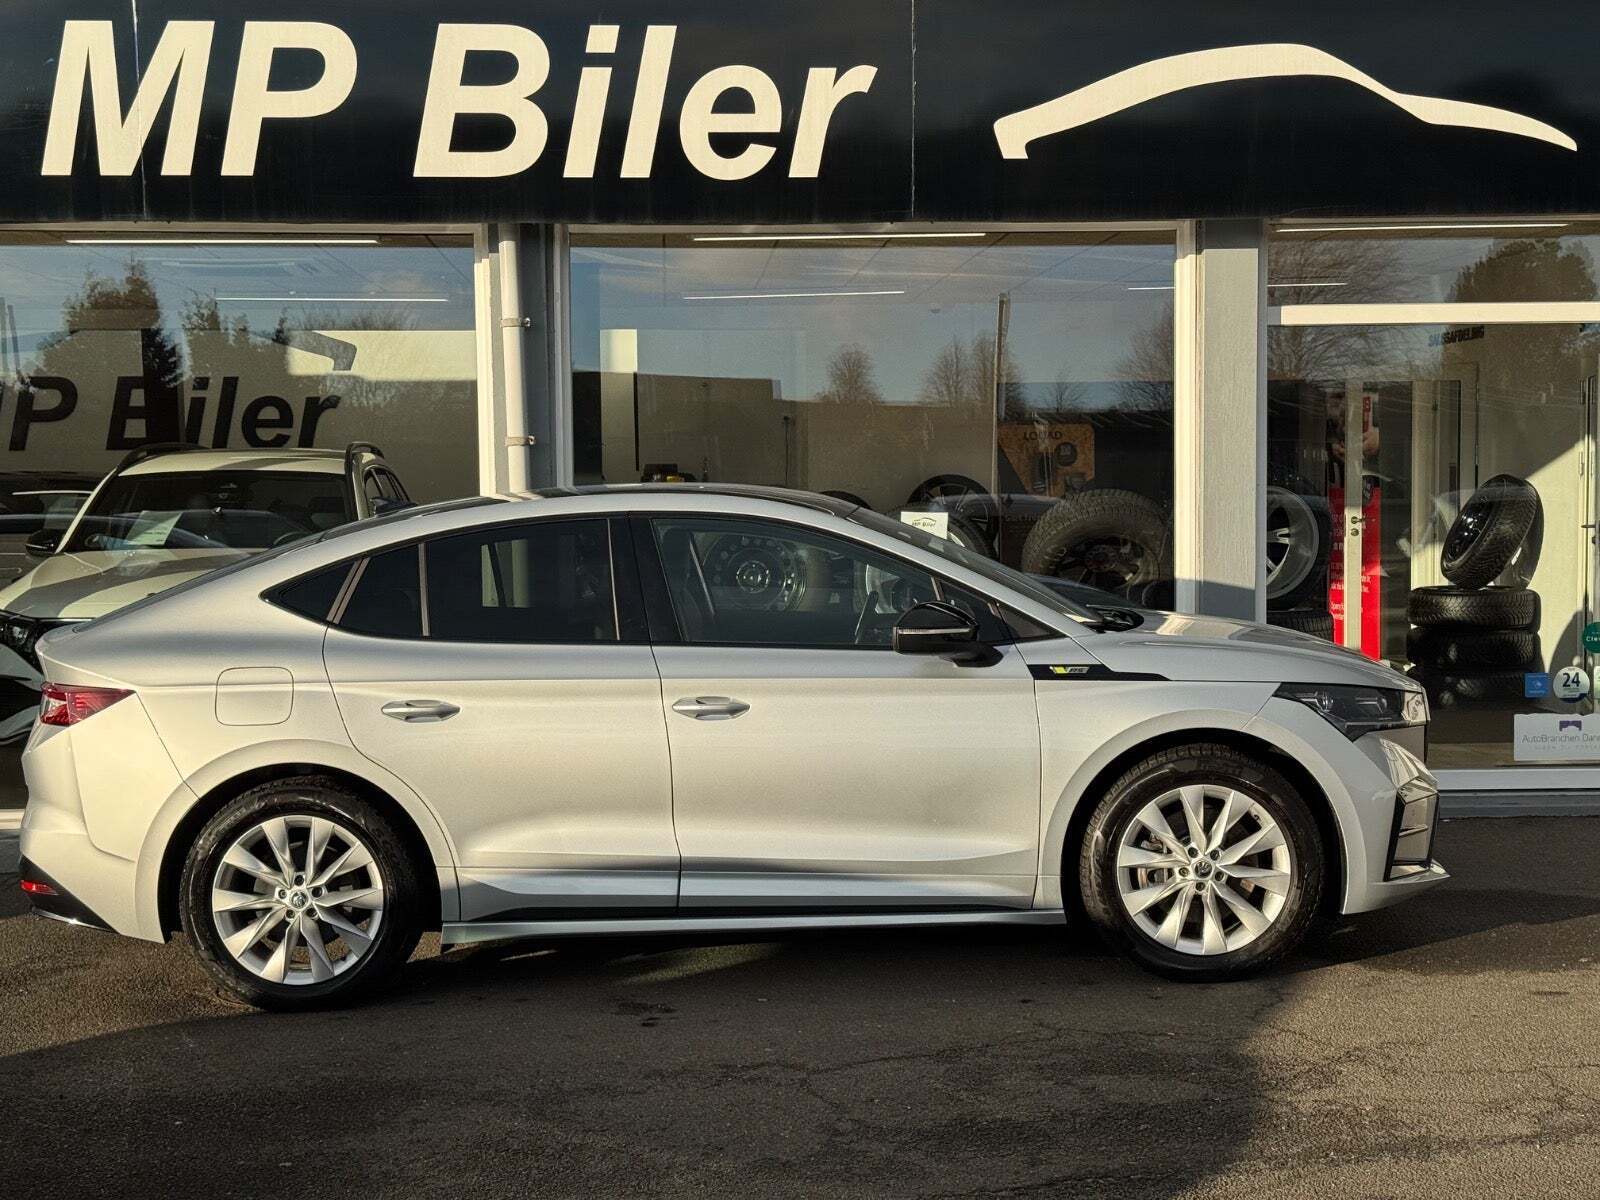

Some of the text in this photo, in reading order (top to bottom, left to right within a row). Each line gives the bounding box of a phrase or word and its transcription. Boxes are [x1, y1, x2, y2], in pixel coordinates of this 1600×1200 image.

[41, 20, 878, 181] MP Biler
[0, 376, 78, 451] P
[1562, 672, 1581, 688] 24
[1521, 734, 1580, 743] AutoBranchen
